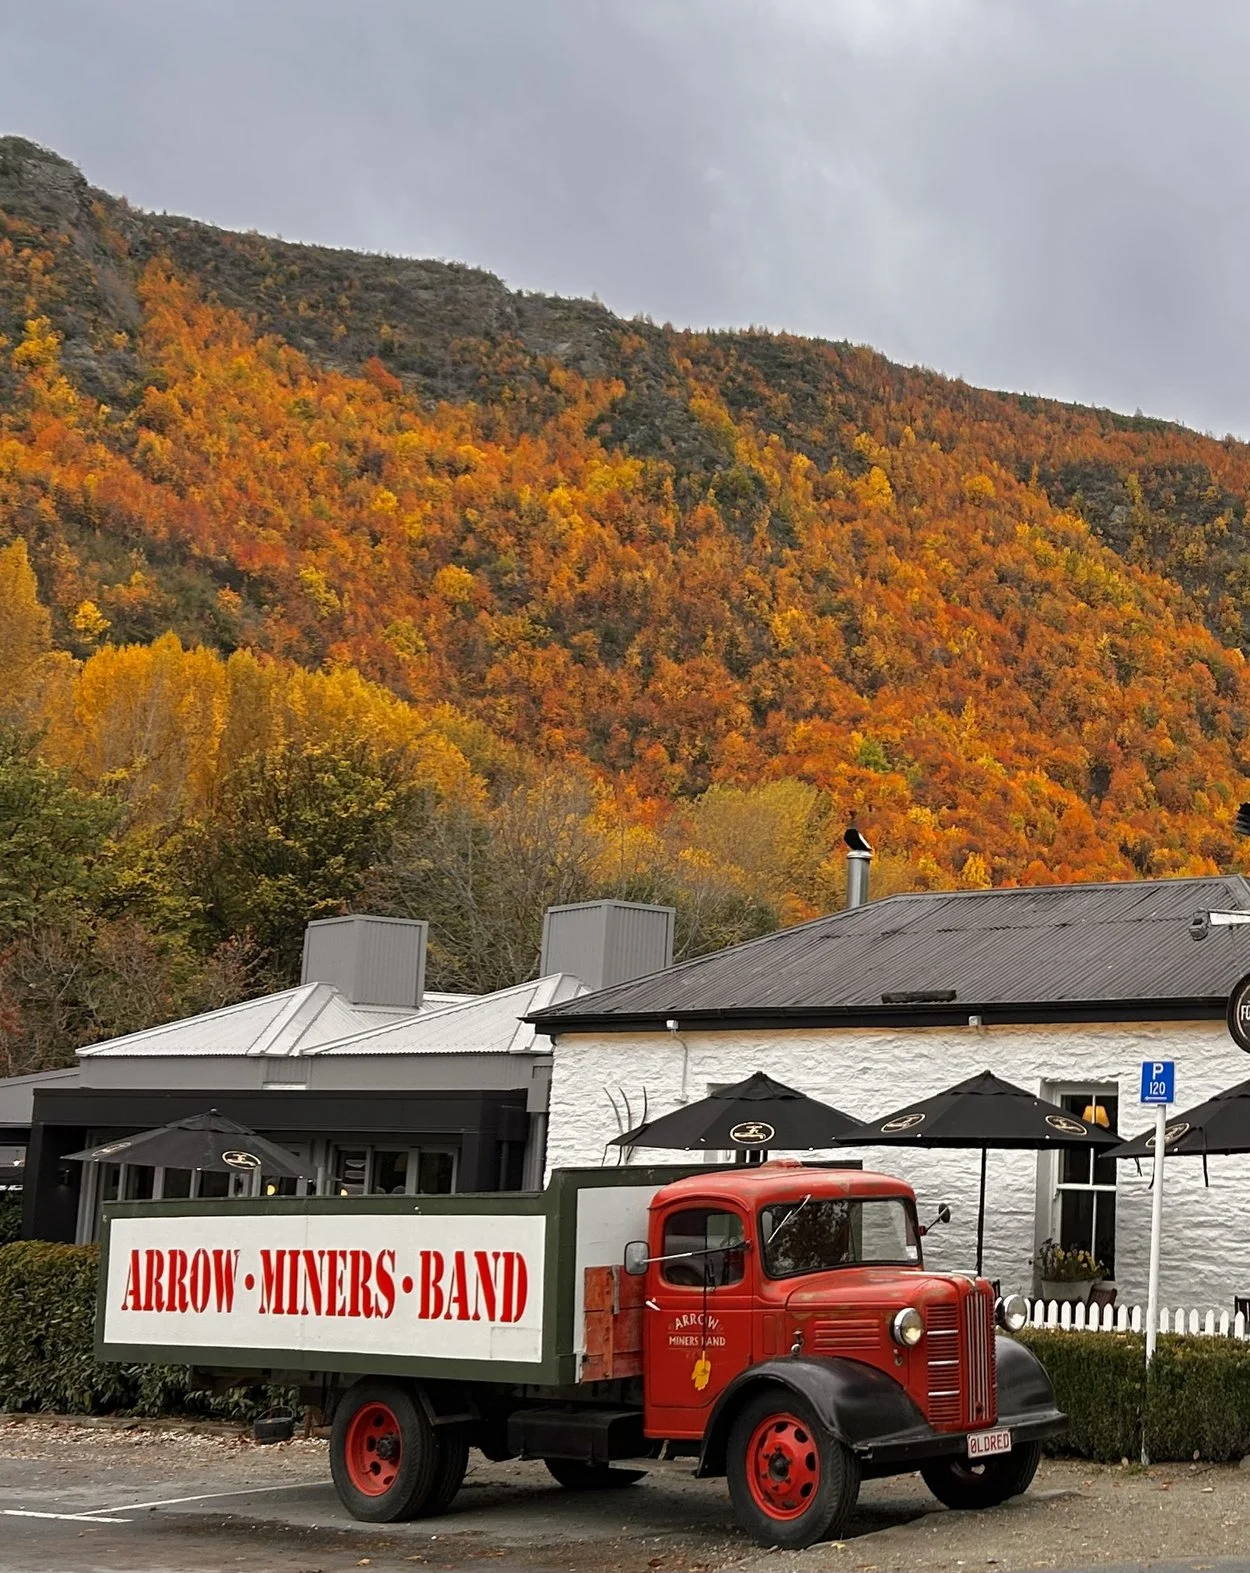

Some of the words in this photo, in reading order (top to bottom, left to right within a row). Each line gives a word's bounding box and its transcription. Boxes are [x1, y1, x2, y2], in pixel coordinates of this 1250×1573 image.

[1152, 1063, 1164, 1080] P
[1149, 1081, 1166, 1095] 120
[121, 1247, 240, 1314] ARROW
[258, 1248, 396, 1319] MINERS
[418, 1250, 528, 1323] BAND
[669, 1336, 699, 1346] MINERS
